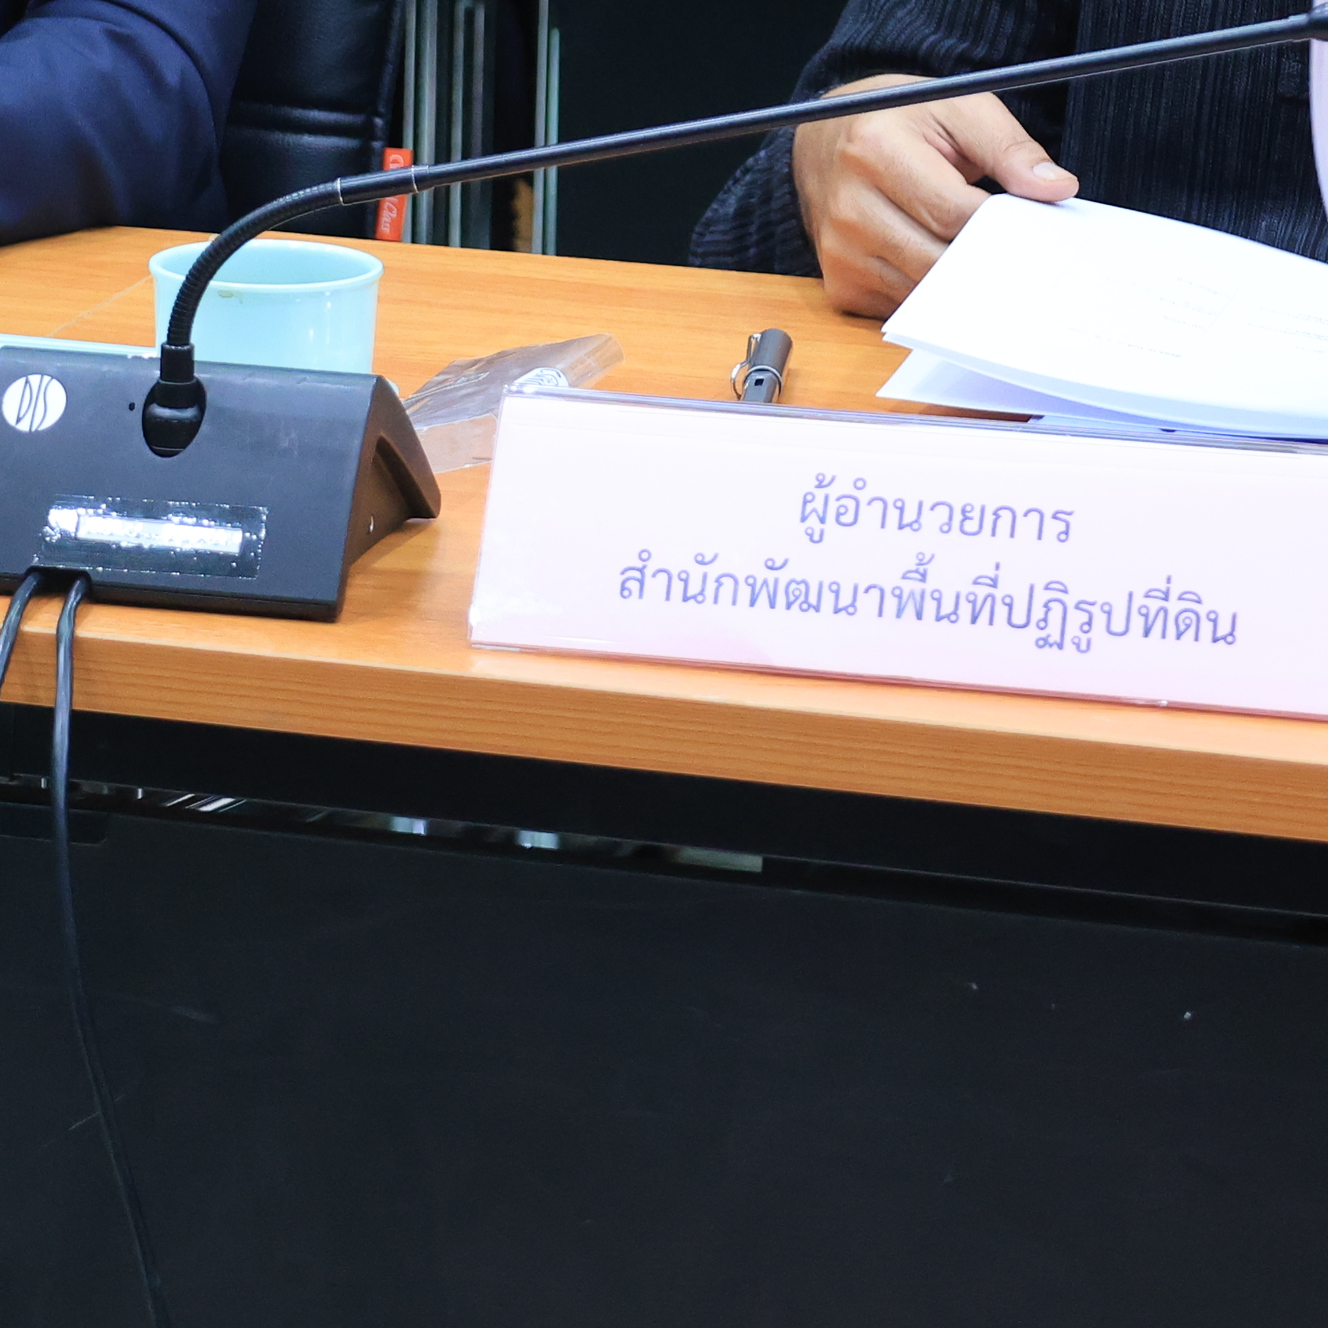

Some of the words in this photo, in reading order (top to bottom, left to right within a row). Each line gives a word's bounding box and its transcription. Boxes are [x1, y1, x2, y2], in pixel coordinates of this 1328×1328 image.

[799, 472, 1075, 544] ผู้อำนวยการ
[618, 548, 1238, 654] สำนักพัฒนาพื้นที่ปฏิรูปที่ดิน
